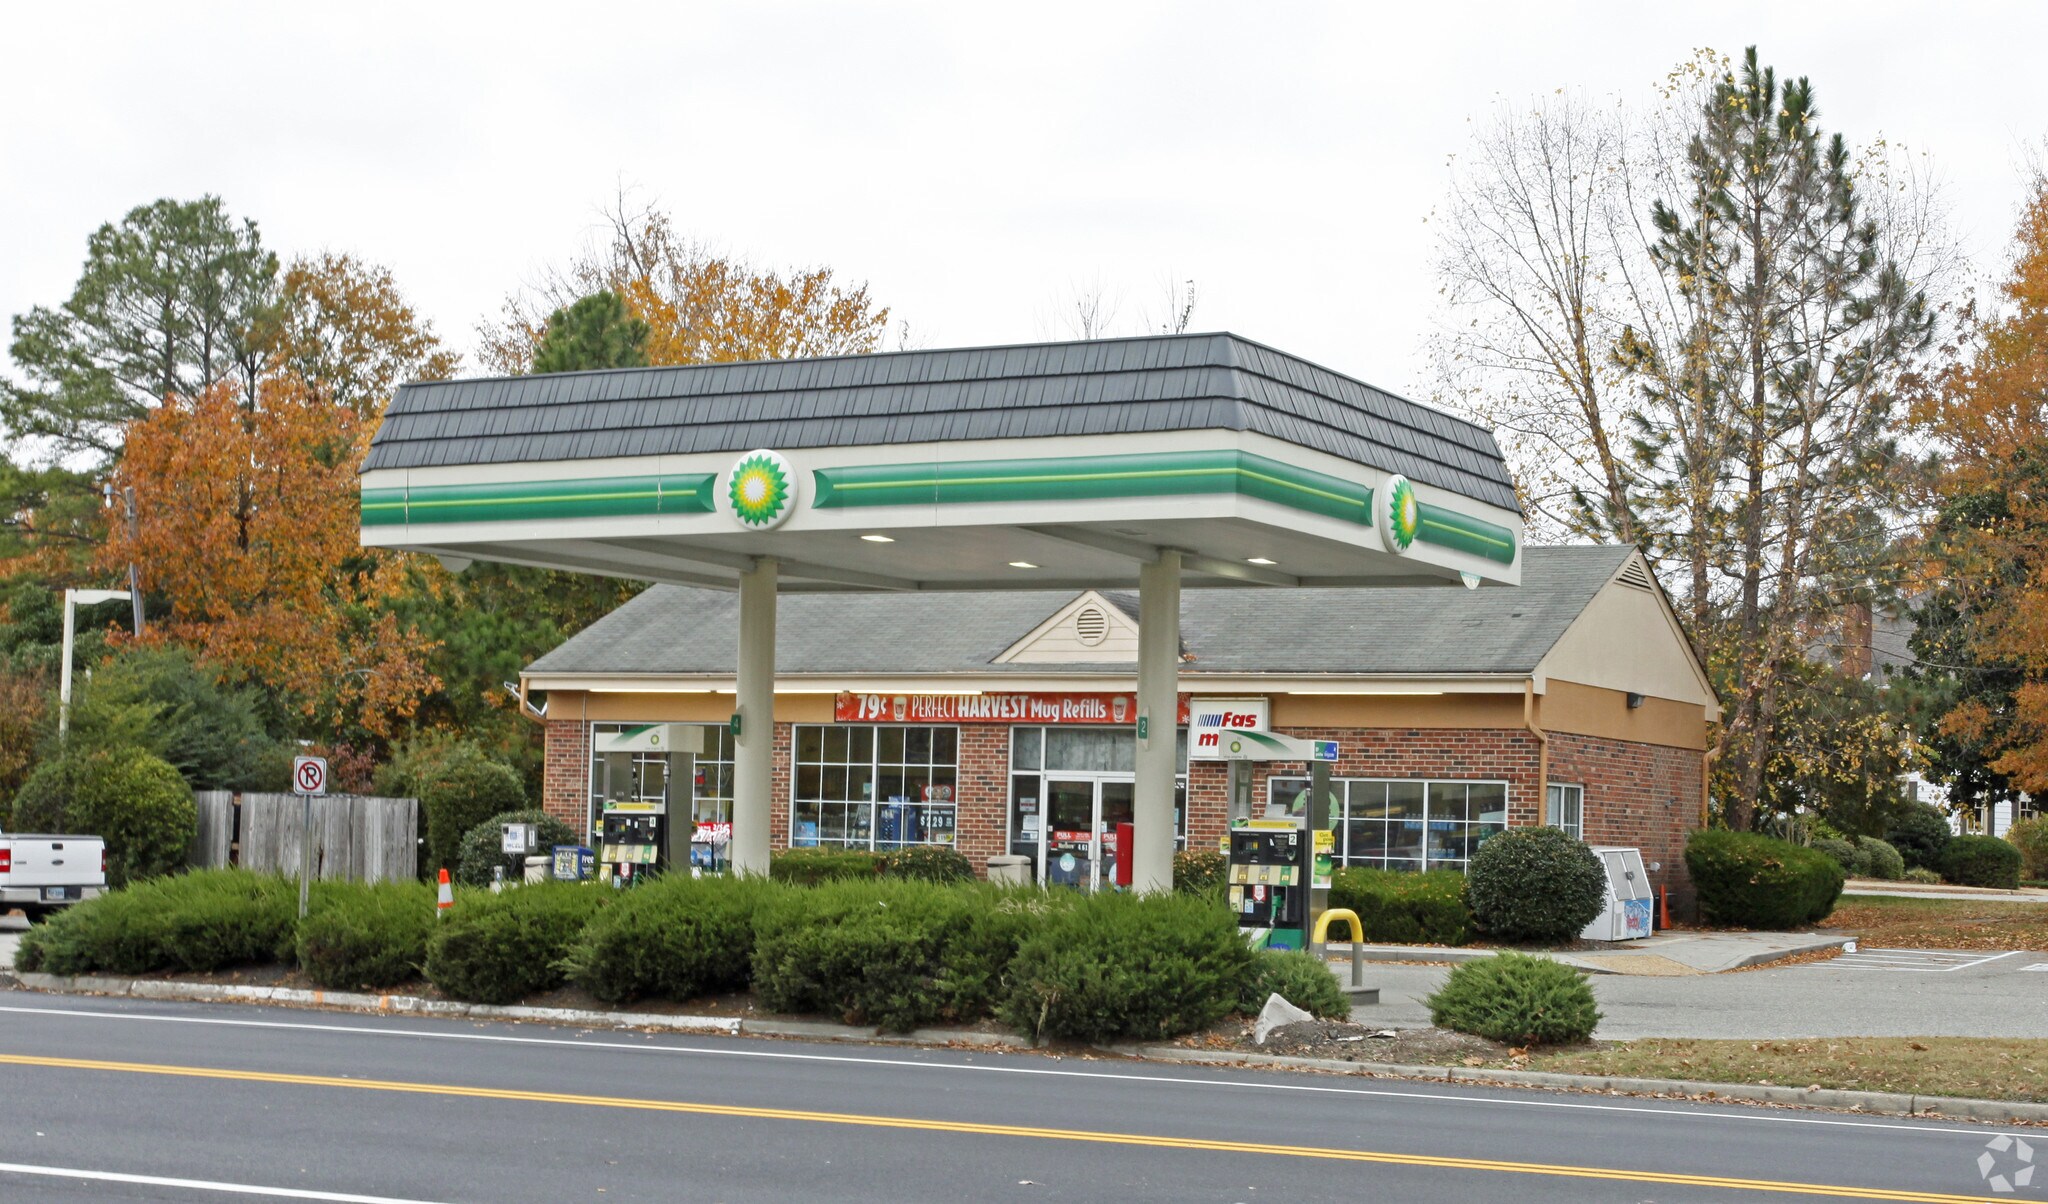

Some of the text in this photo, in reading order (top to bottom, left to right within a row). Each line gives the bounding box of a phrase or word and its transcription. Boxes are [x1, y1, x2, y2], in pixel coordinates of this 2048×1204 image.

[857, 694, 1107, 722] 79¢ PERFECT HARVEST Mug Refills
[1141, 720, 1147, 733] 2
[306, 766, 317, 785] P
[1290, 835, 1296, 844] 2
[581, 854, 595, 864] Free
